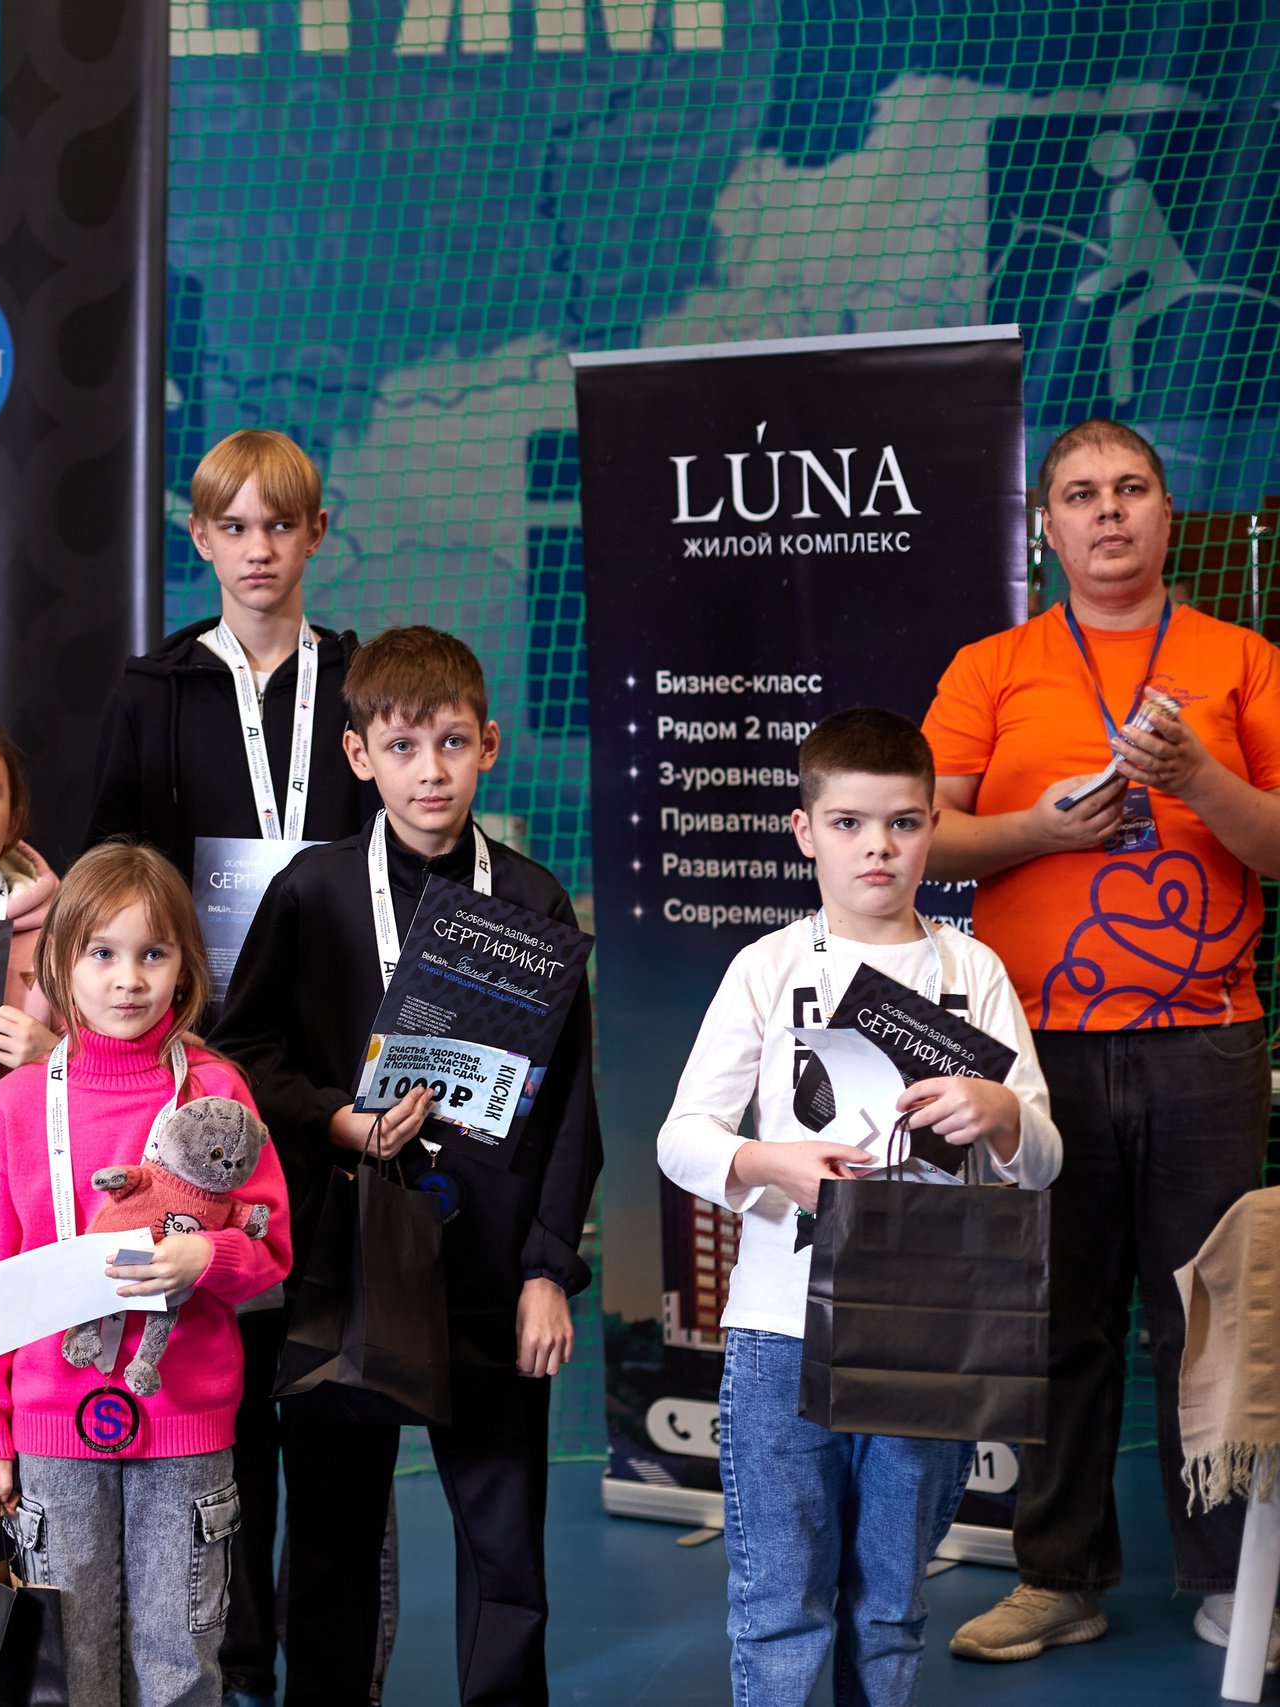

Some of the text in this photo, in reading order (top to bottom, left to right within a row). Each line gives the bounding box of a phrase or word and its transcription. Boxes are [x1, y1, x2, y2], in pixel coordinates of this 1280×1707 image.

[669, 421, 921, 523] LÚNA
[683, 531, 911, 558] ЖИЛОЙ КОМПЛЕКС
[656, 670, 822, 694] Бизнес-класс
[657, 716, 737, 743] Рядом
[744, 716, 760, 739] 2
[661, 807, 793, 836] Приватная
[662, 853, 777, 879] Развитая
[210, 872, 269, 889] СЕРТИ
[433, 918, 565, 979] СЕРТИФИКАТ
[539, 941, 553, 953] 2.0
[960, 1049, 975, 1062] 2.0
[383, 1060, 488, 1083] И ПОКУШАТЬ НА СДАЧУ
[93, 1399, 122, 1440] S
